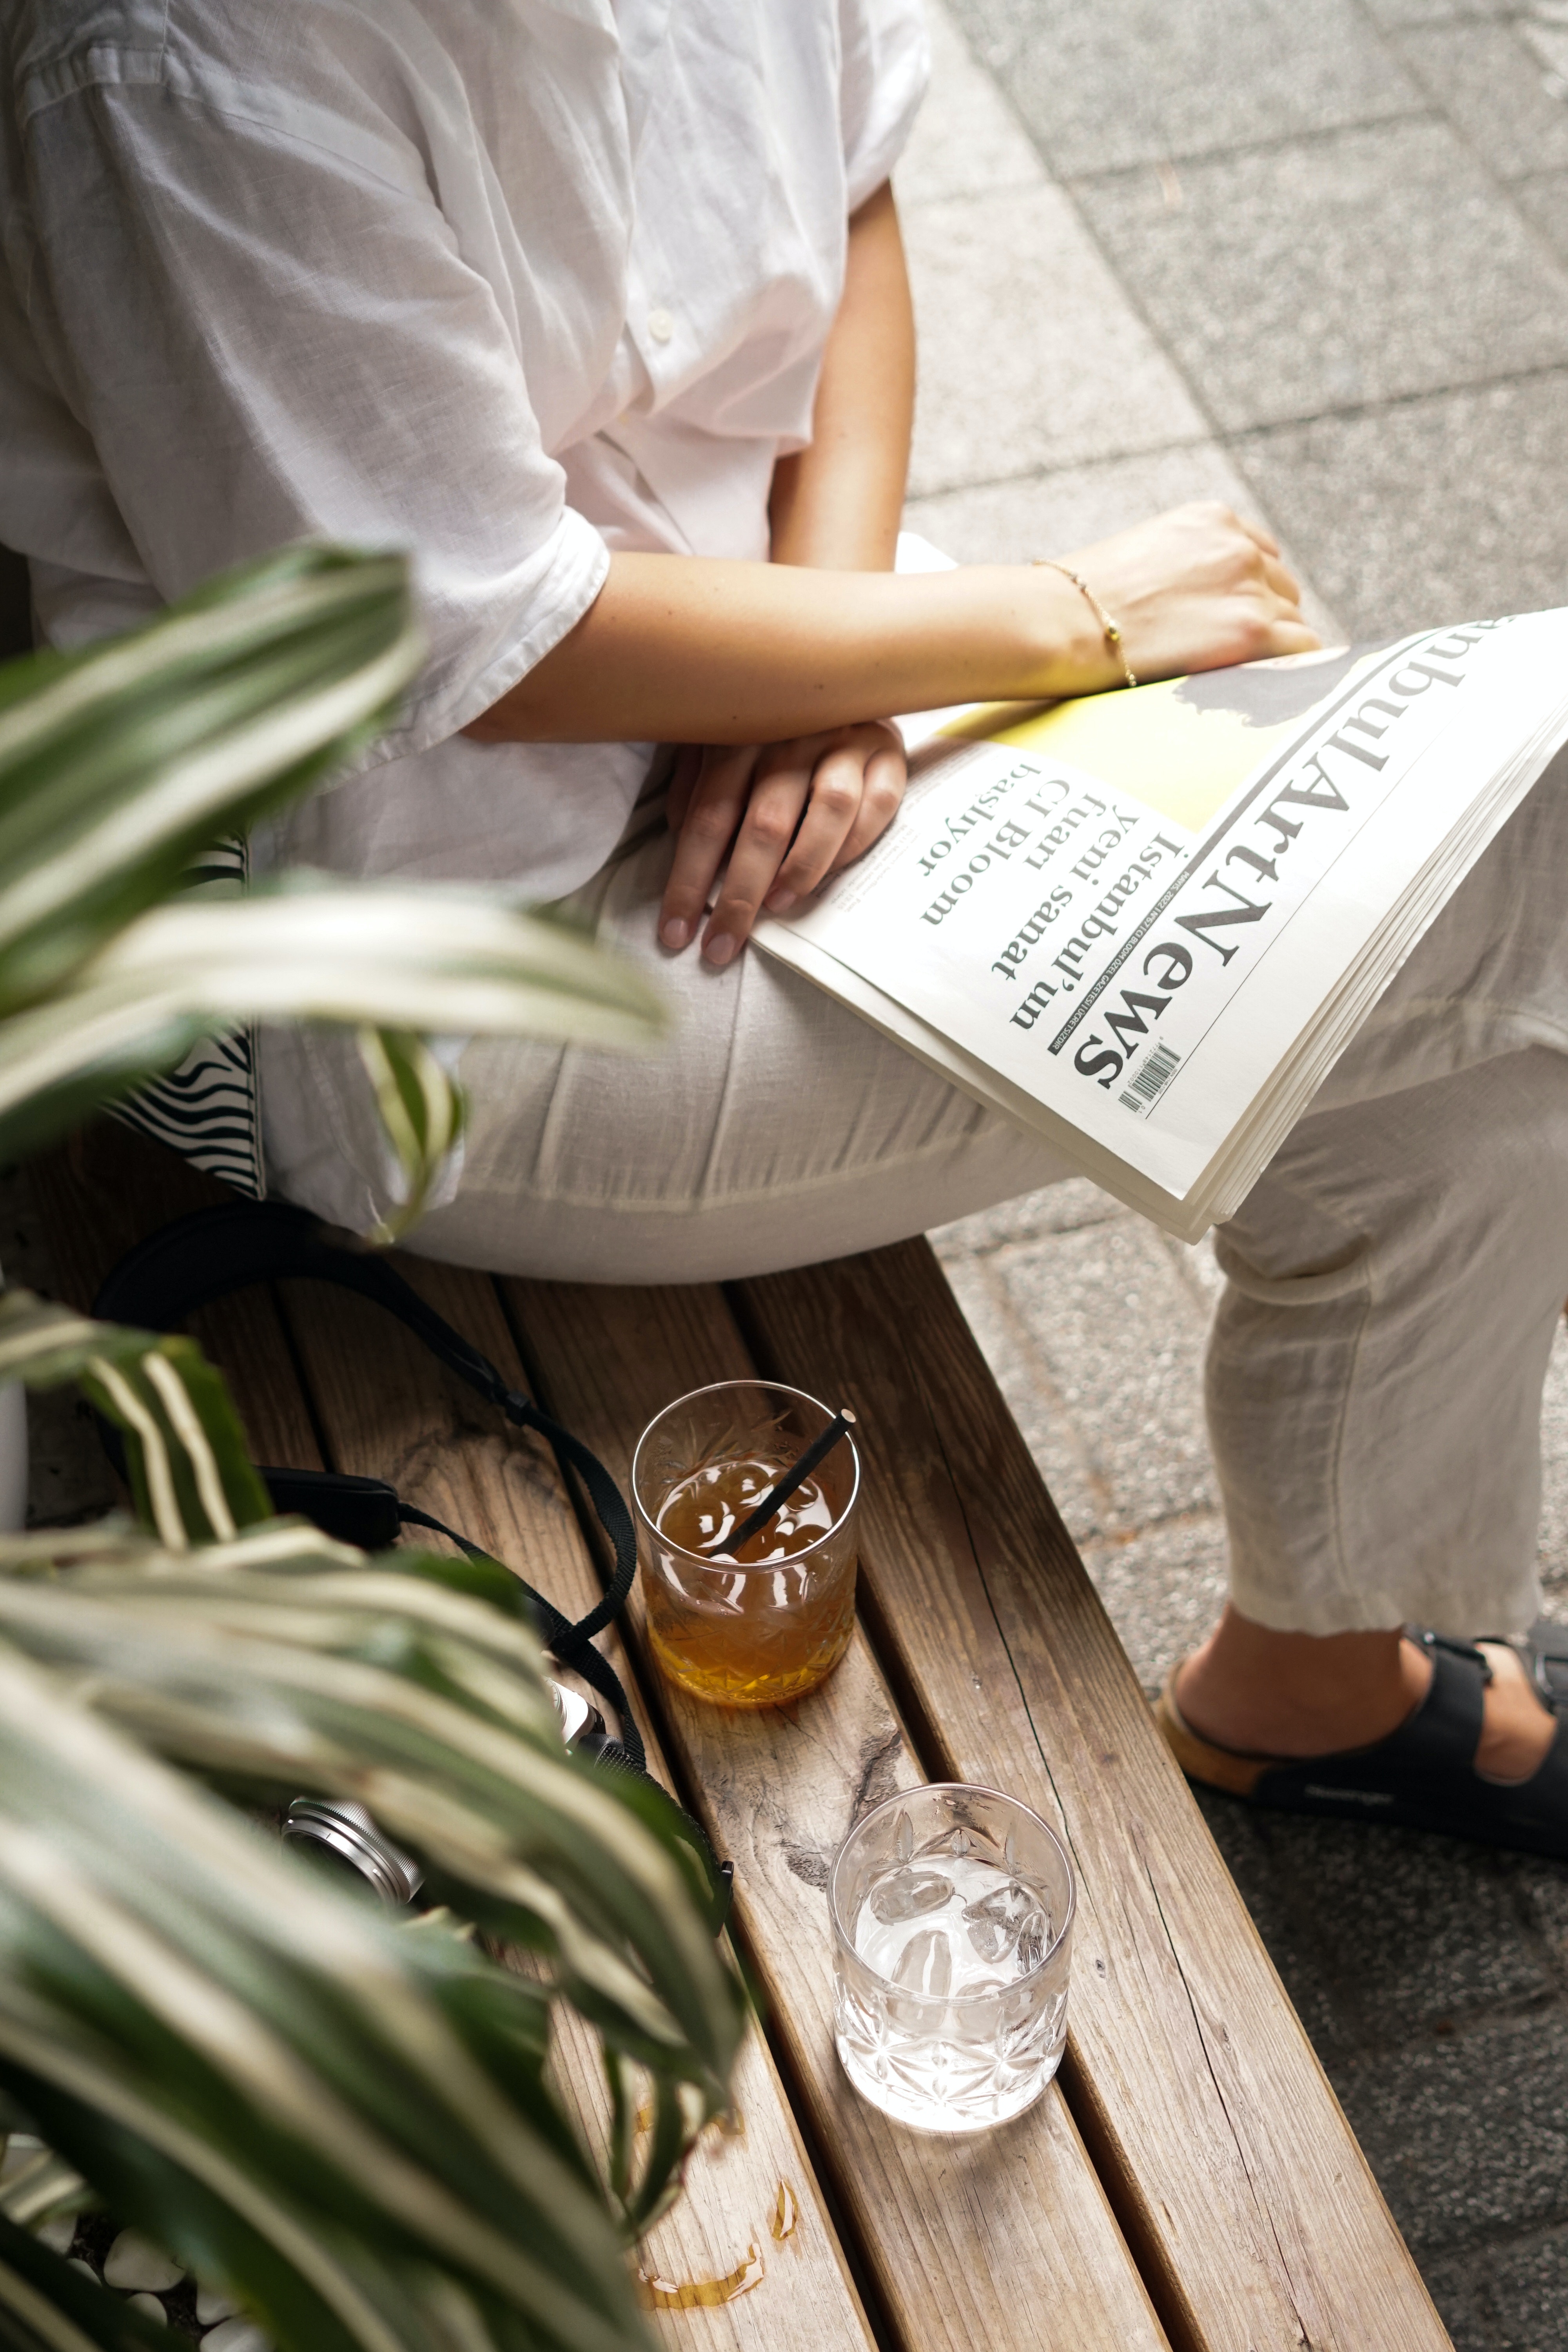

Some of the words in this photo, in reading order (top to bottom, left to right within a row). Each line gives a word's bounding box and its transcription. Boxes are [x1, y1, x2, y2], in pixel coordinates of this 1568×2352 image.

[1024, 780, 1069, 818] CI
[916, 764, 1042, 877] başlıyor
[1024, 794, 1106, 870] fuarı
[1069, 805, 1139, 885] yeni
[920, 820, 1031, 925] Bloom
[1158, 891, 1174, 908] 2022
[991, 885, 1073, 980] sanat
[1120, 936, 1138, 959] BLOOM
[1136, 929, 1143, 938] CI
[1106, 958, 1122, 974] ÖZEL
[1084, 975, 1110, 1006] GAZETESİ
[1052, 1008, 1085, 1049] ÜCRETSİZDİR
